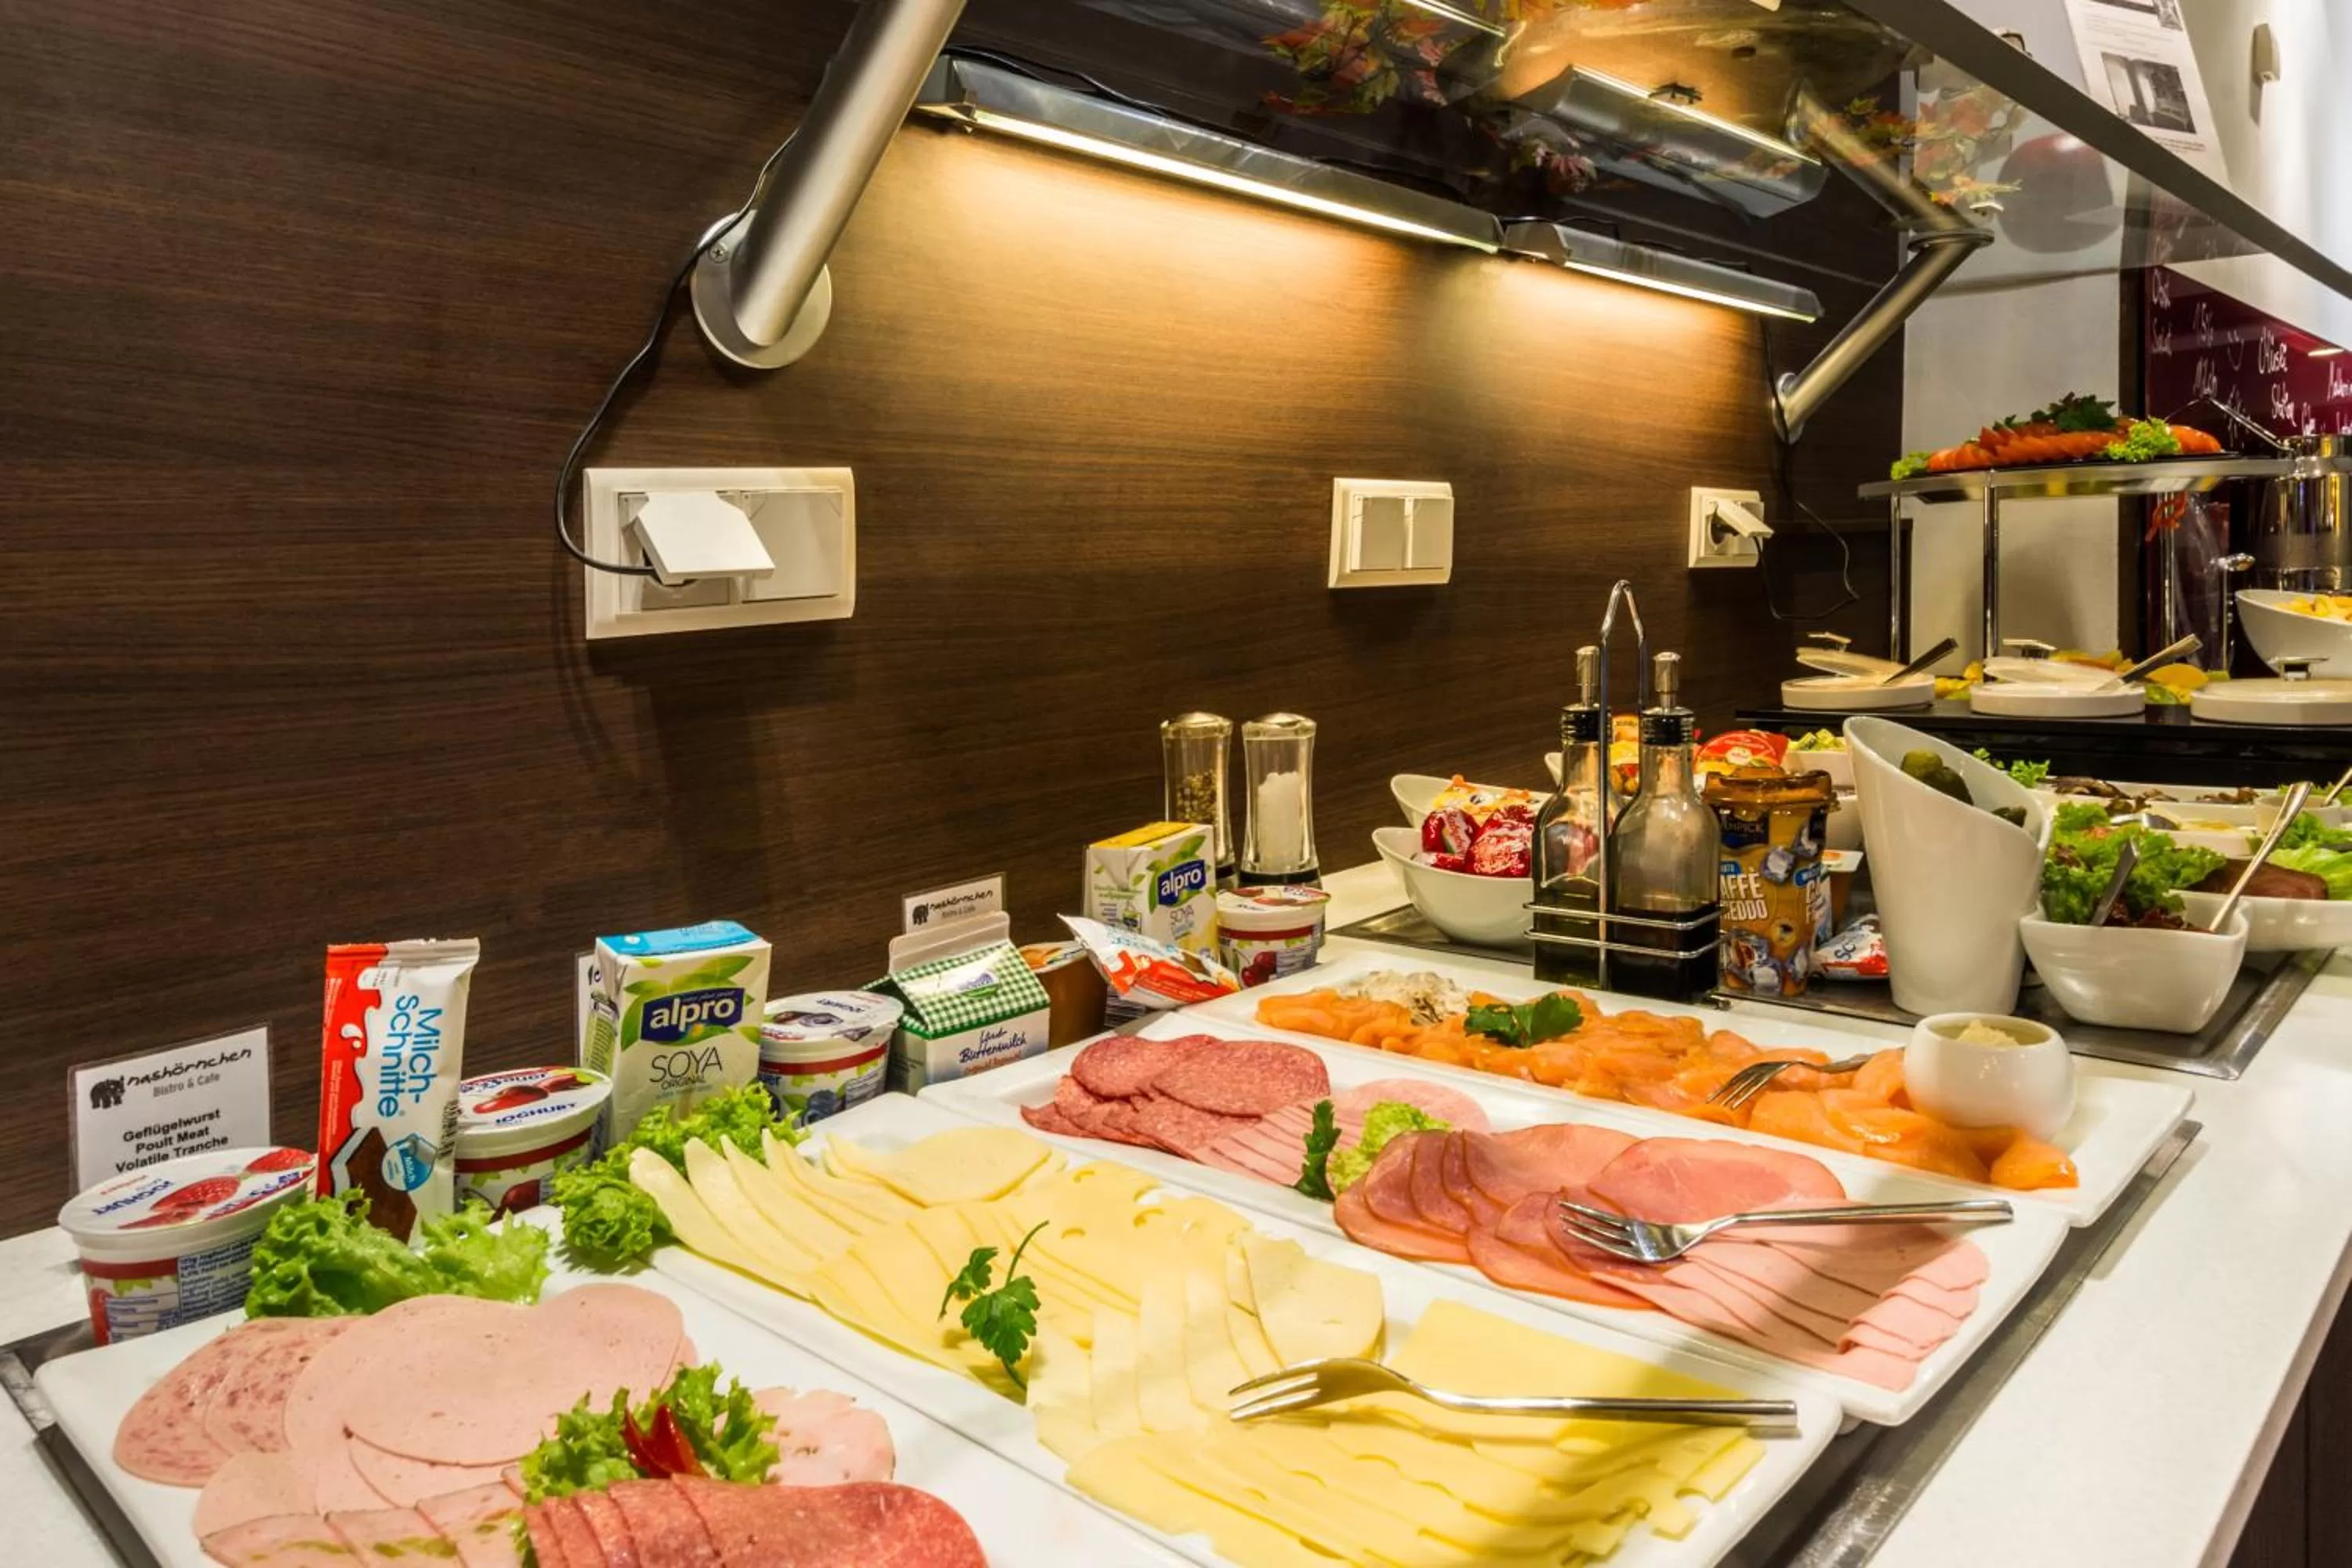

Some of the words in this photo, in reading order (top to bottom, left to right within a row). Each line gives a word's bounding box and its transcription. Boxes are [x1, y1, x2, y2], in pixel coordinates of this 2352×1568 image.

[1160, 868, 1202, 898] alpro
[1720, 866, 1766, 900] AFFÈ
[1720, 899, 1768, 921] EDDO
[649, 997, 736, 1033] alpro
[126, 1048, 252, 1087] nashörnchen
[377, 993, 419, 1118] schnitte
[408, 1007, 443, 1104] Milch-
[649, 1046, 723, 1083] SOYA
[122, 1109, 221, 1143] Geflügelwurst
[135, 1135, 173, 1154] Poult
[176, 1125, 210, 1142] Meat
[115, 1152, 170, 1174] Volatile
[173, 1136, 230, 1159] Tranche
